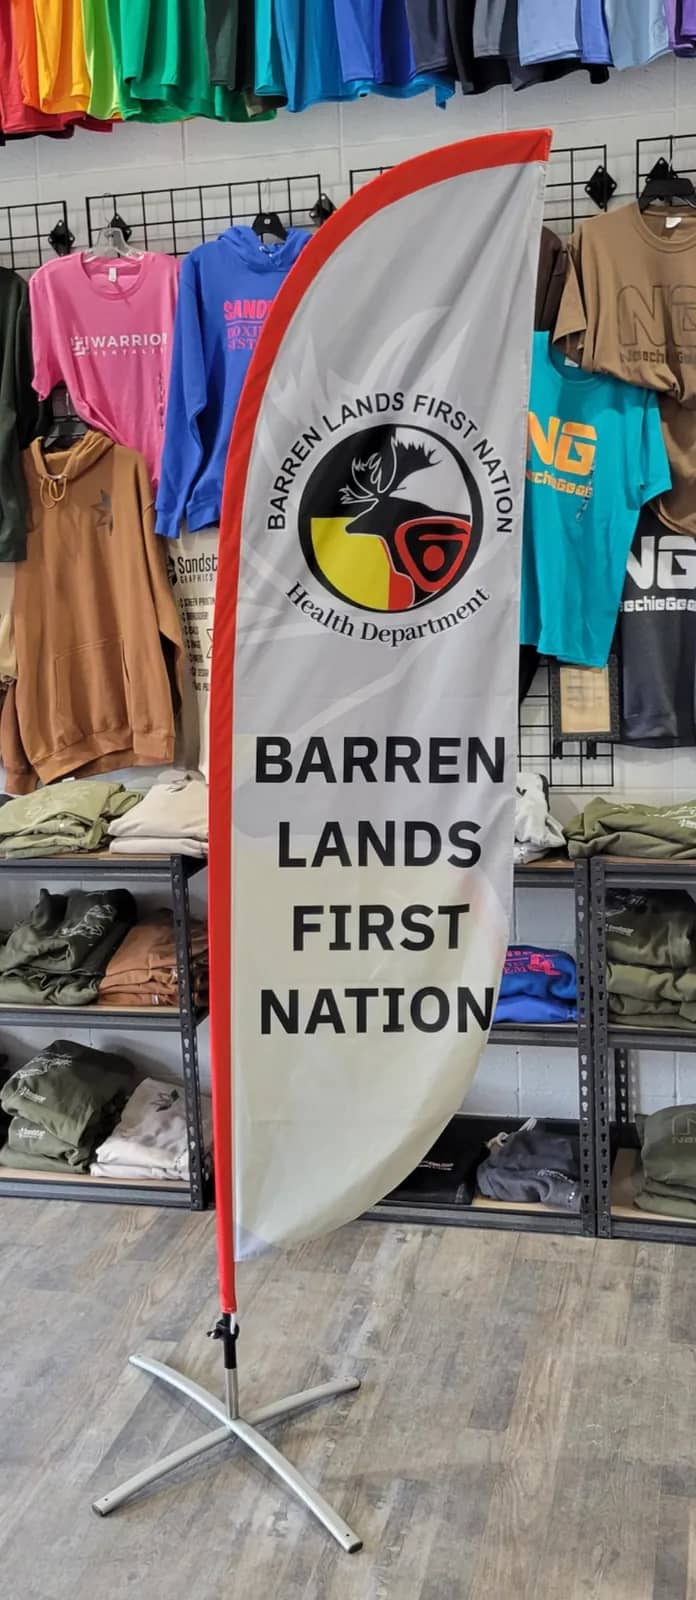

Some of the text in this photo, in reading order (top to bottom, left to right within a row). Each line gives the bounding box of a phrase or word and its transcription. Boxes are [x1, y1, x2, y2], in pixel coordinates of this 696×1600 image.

[224, 299, 273, 321] SAND
[267, 427, 322, 530] BARREN
[323, 392, 405, 433] LANDS
[413, 394, 478, 439] FIRST
[473, 439, 513, 533] NATION
[285, 581, 490, 648] Health Department
[255, 736, 505, 784] BARREN
[278, 821, 482, 868] LANDS
[292, 904, 470, 951] FIRST
[260, 986, 494, 1035] NATION
